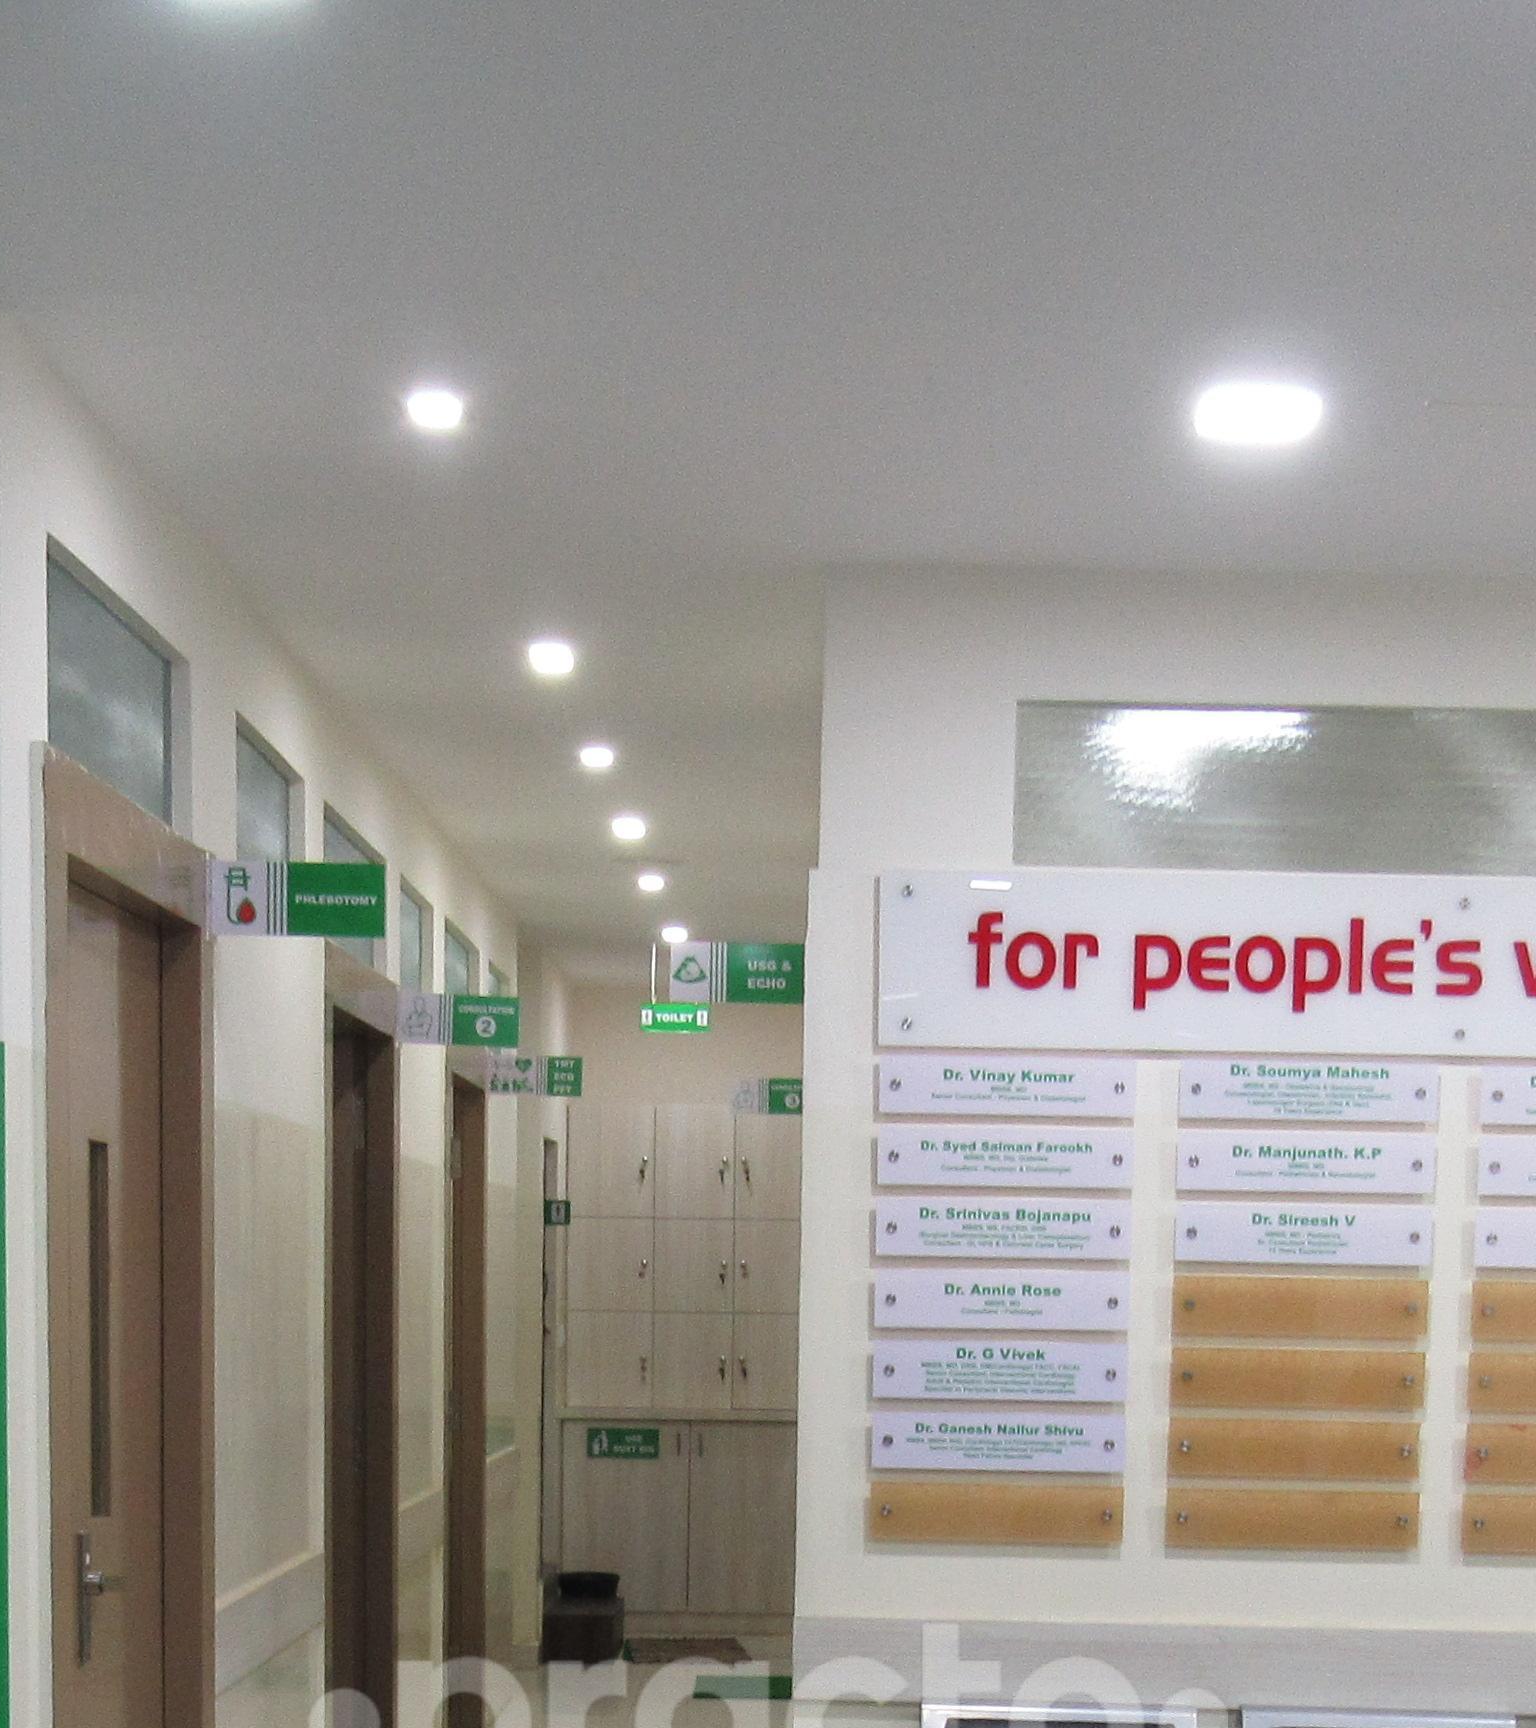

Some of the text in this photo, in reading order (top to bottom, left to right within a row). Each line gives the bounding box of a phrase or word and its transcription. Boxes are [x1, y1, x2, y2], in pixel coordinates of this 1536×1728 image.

[296, 895, 377, 906] PHLEBOTOMY
[748, 960, 791, 971] USG &
[967, 911, 1098, 991] for
[1132, 917, 1484, 1012] people's
[748, 978, 786, 989] ECHO
[656, 1013, 694, 1023] TOILET
[481, 1020, 492, 1033] 2
[943, 1069, 1075, 1084] Dr. Vinay Kumar
[1230, 1064, 1389, 1080] Dr. Soumya Mahesh
[920, 1141, 938, 1151] Dr.
[943, 1141, 976, 1152] Syed
[1232, 1146, 1252, 1157] Dr.
[1354, 1148, 1382, 1159] K.P
[919, 1207, 939, 1219] Dr.
[946, 1207, 1010, 1220] Srinivas
[1252, 1213, 1272, 1225] Dr.
[1345, 1215, 1356, 1226] V
[944, 1284, 1061, 1297] Dr. Annie Rose
[956, 1348, 976, 1359] Dr.
[1000, 1349, 1045, 1360] Vivek
[915, 1423, 933, 1433] Dr.
[939, 1423, 991, 1435] Ganesh
[1045, 1425, 1083, 1436] Shivu
